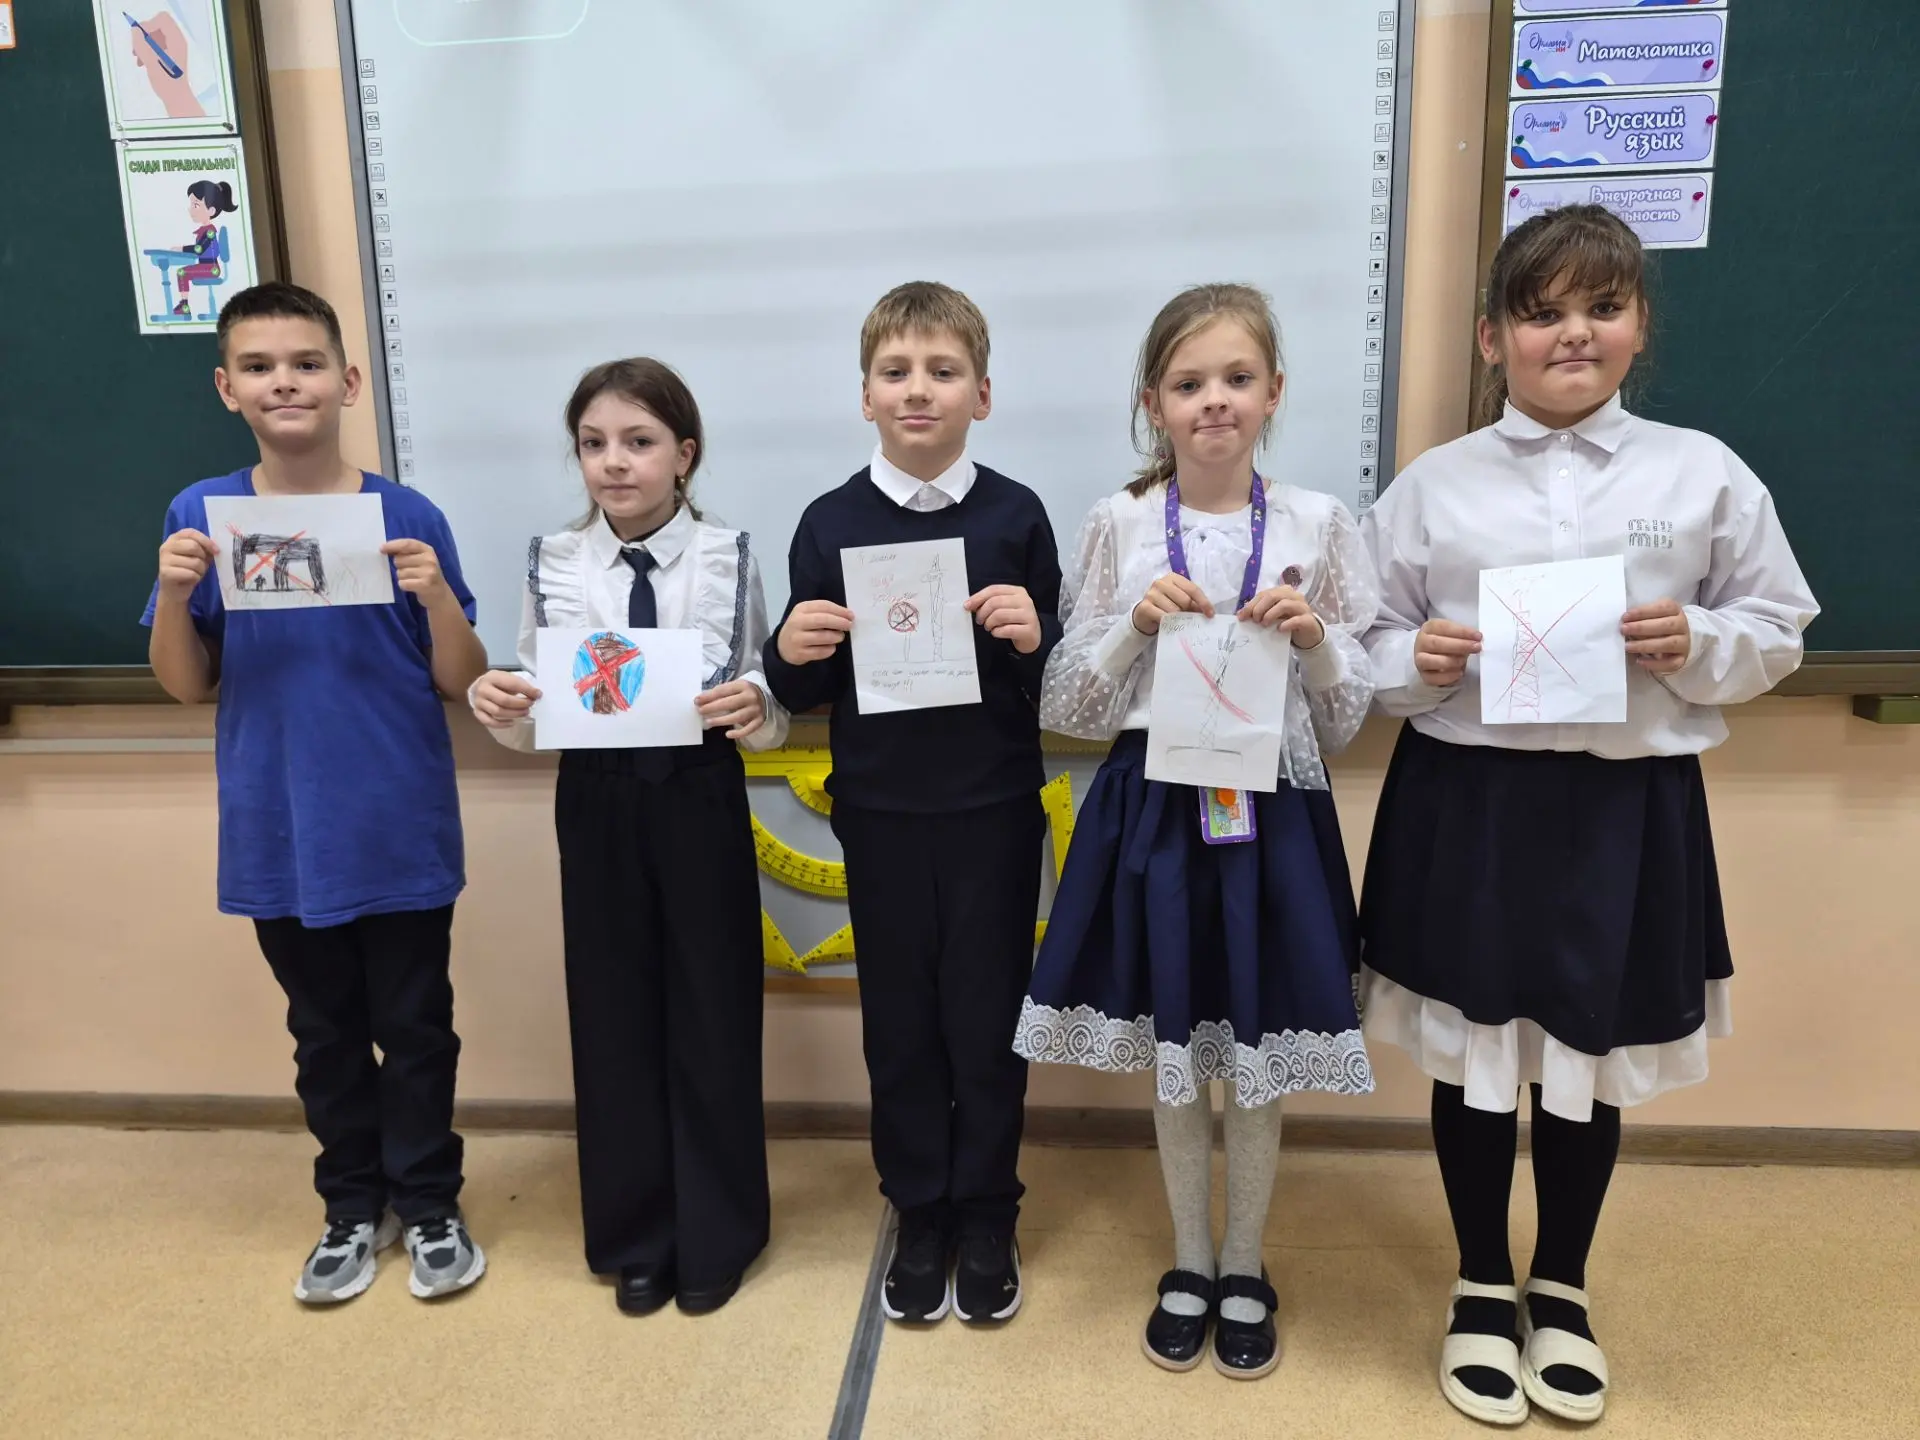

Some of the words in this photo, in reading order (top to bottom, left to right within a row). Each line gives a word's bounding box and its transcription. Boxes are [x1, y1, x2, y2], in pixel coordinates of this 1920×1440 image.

[1578, 39, 1714, 62] Математика
[1584, 105, 1685, 139] Русский
[1624, 133, 1683, 159] язык
[128, 160, 160, 174] СИДИ
[162, 157, 236, 172] ПРАВИЛЬНО!
[1590, 186, 1681, 207] Внеурочная
